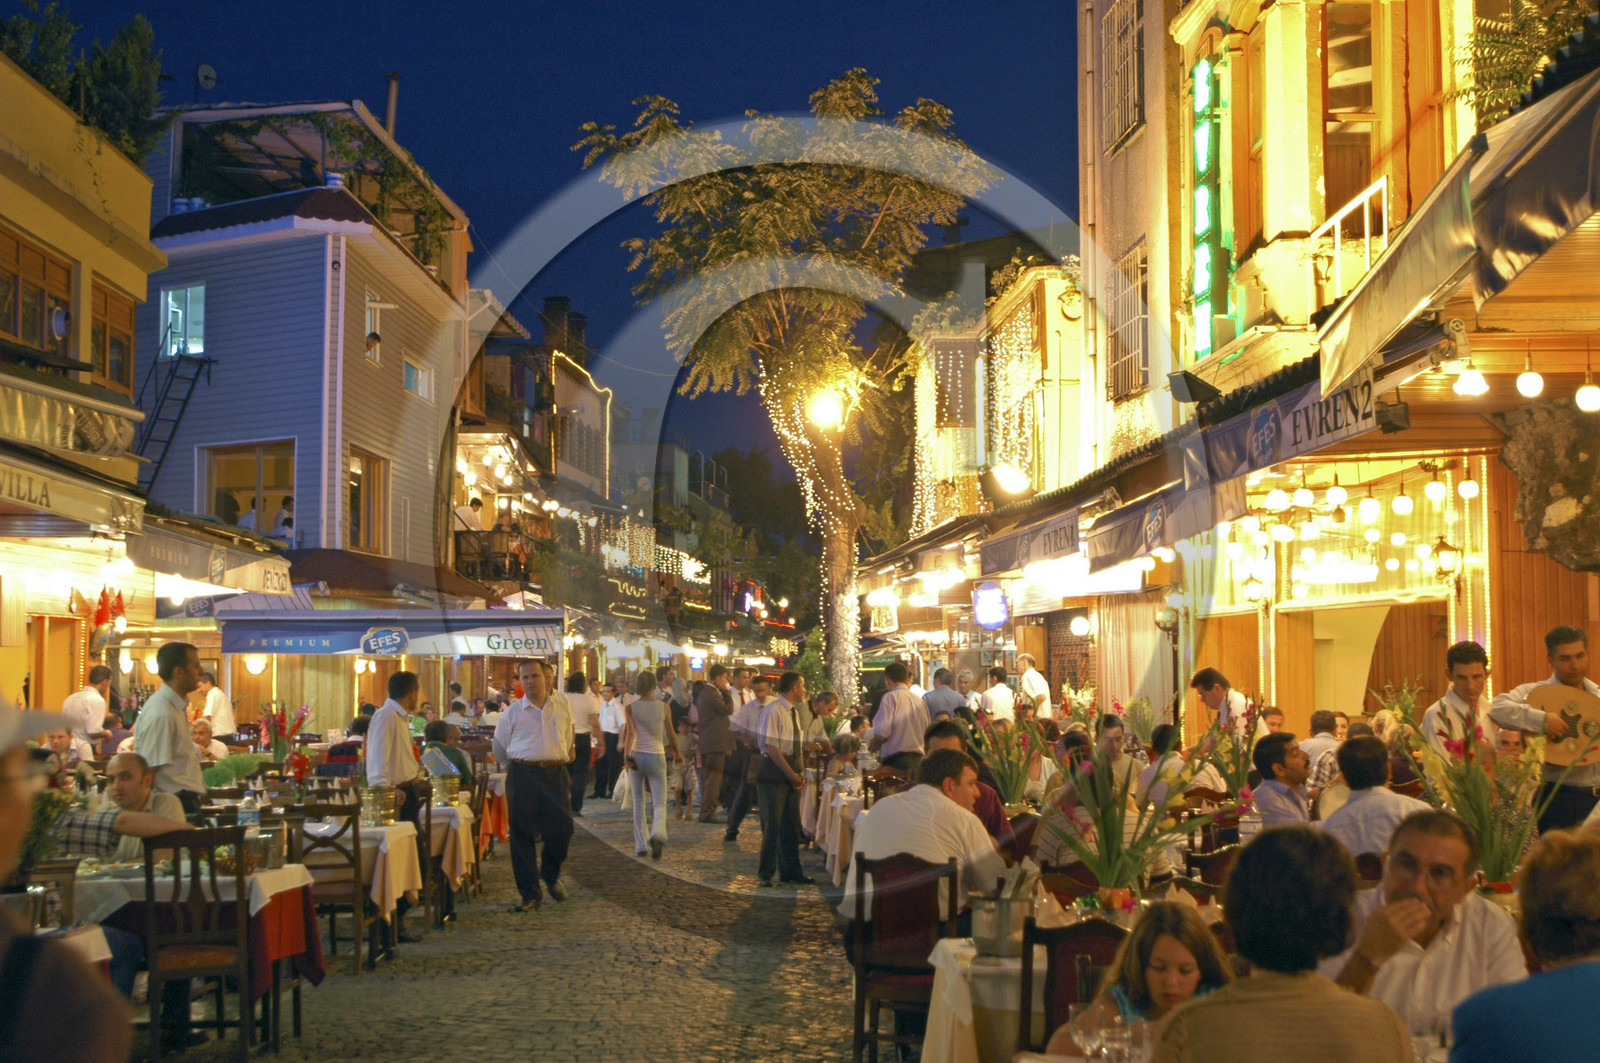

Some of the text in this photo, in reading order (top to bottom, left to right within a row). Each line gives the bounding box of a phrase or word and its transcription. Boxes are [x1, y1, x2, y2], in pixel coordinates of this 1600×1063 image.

[1291, 380, 1373, 447] EVREN2
[1252, 413, 1276, 458] EFES
[189, 599, 209, 613] EFES
[249, 638, 331, 647] PREMIUM
[369, 631, 401, 650] EFES
[487, 633, 549, 650] Green
